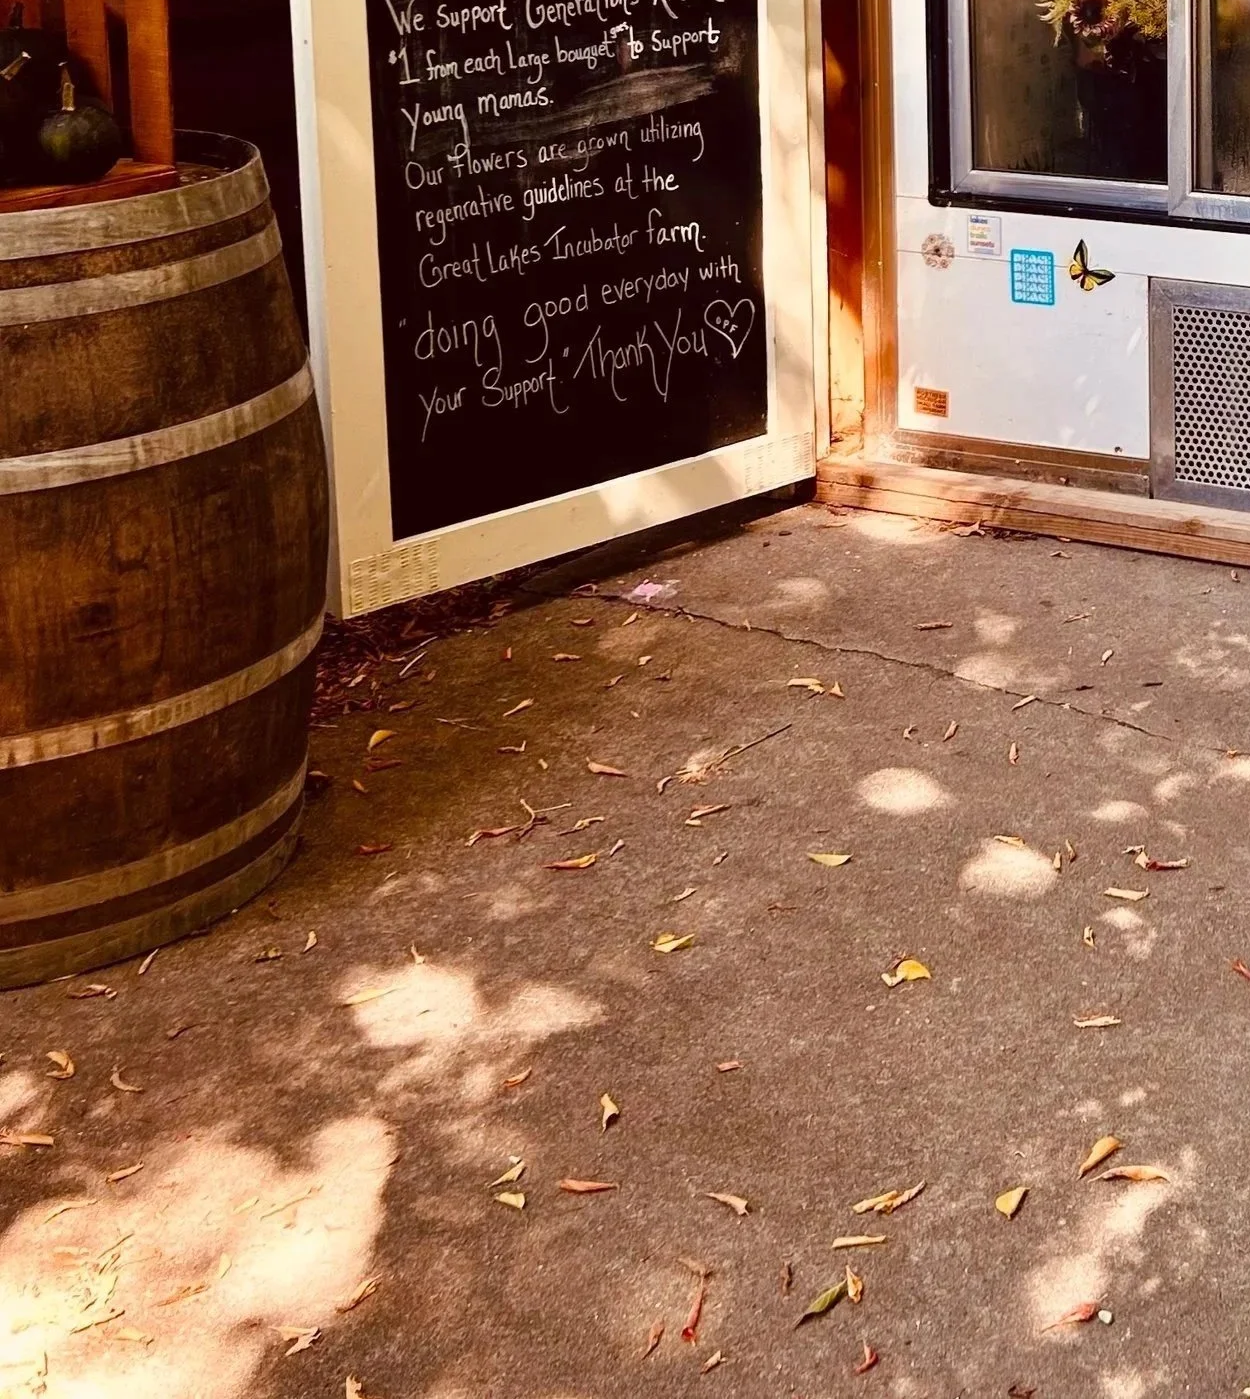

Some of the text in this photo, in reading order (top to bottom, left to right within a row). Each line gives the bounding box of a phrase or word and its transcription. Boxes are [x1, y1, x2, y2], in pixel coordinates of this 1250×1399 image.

[426, 49, 463, 82] from
[464, 53, 506, 76] each
[555, 30, 617, 70] bouquet
[626, 25, 644, 60] to
[405, 160, 444, 190] Our
[538, 142, 569, 164] are
[577, 129, 632, 173] grown
[640, 114, 705, 162] utilizing
[523, 173, 605, 221] guidelines
[614, 162, 639, 199] at
[642, 161, 680, 193] the
[419, 242, 487, 289] Great
[543, 224, 639, 261] Incubator
[523, 284, 589, 363] good
[601, 267, 690, 304] everyday
[699, 255, 742, 284] with
[653, 307, 709, 402] You
